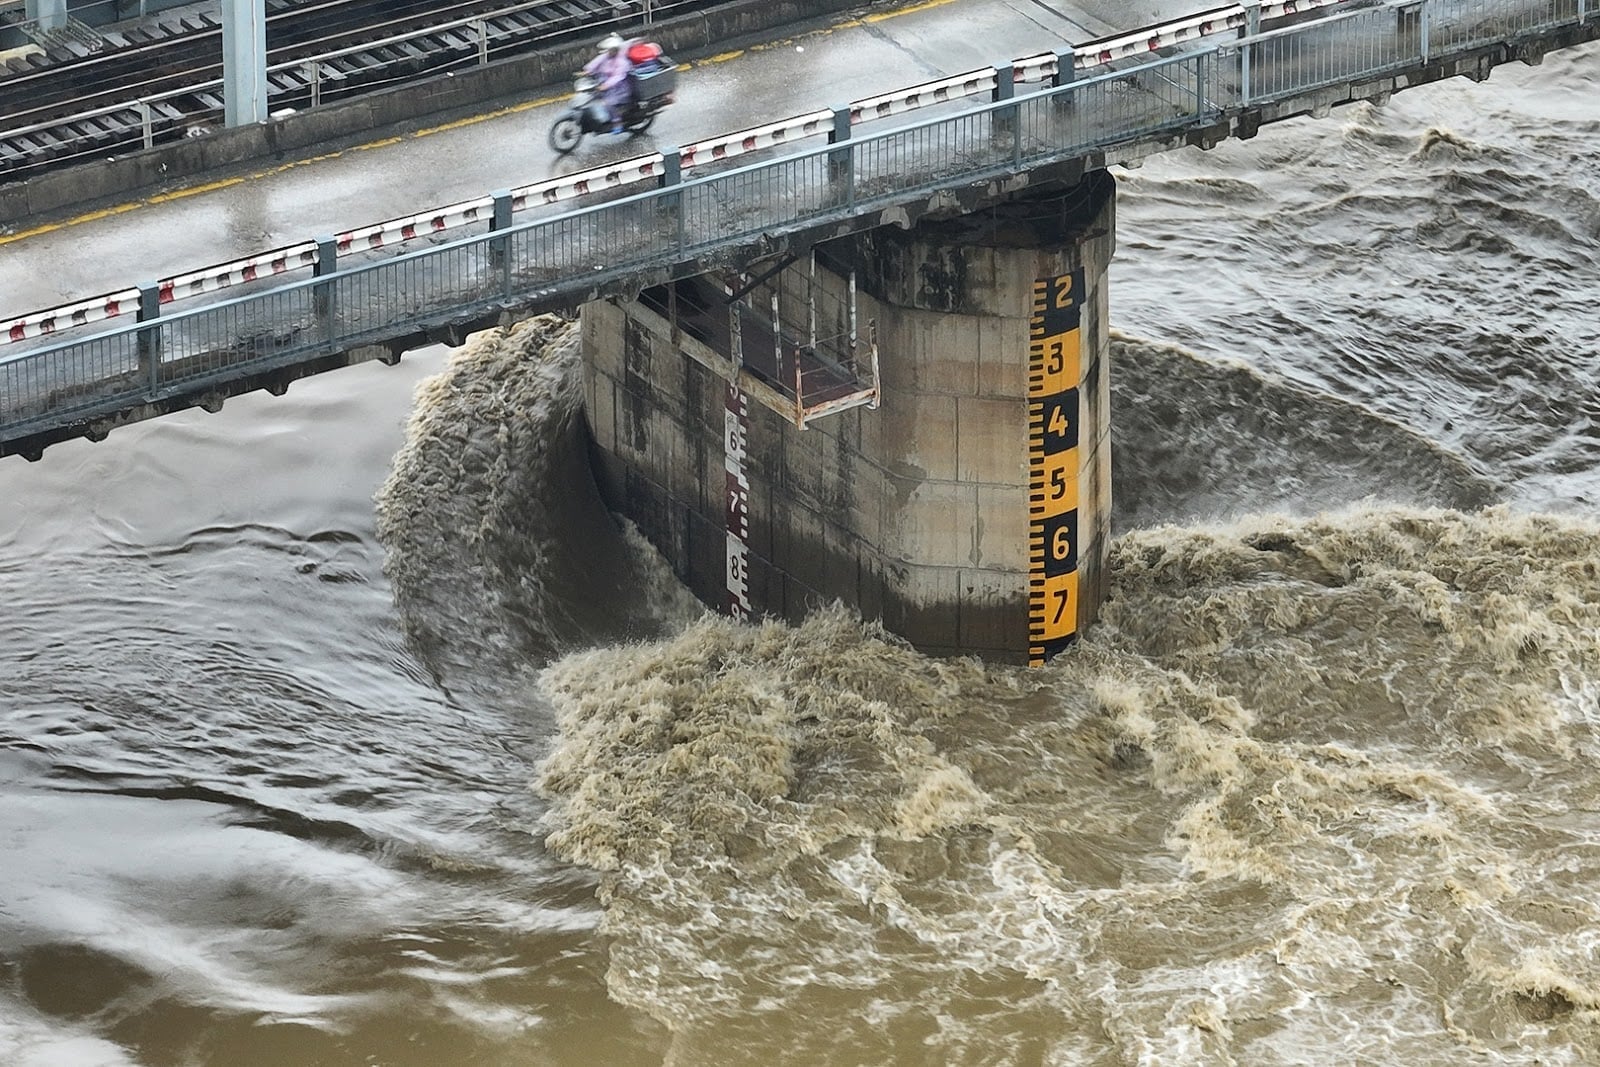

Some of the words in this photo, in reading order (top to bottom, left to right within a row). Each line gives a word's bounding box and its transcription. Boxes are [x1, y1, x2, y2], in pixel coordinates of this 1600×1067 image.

[1054, 274, 1074, 309] 2
[1047, 342, 1064, 375] 3
[1047, 405, 1069, 437] 4
[730, 431, 738, 451] 6
[1051, 467, 1066, 500] 5
[730, 490, 739, 513] 7
[1052, 525, 1070, 561] 6
[731, 555, 739, 581] 8
[1053, 588, 1068, 625] 7
